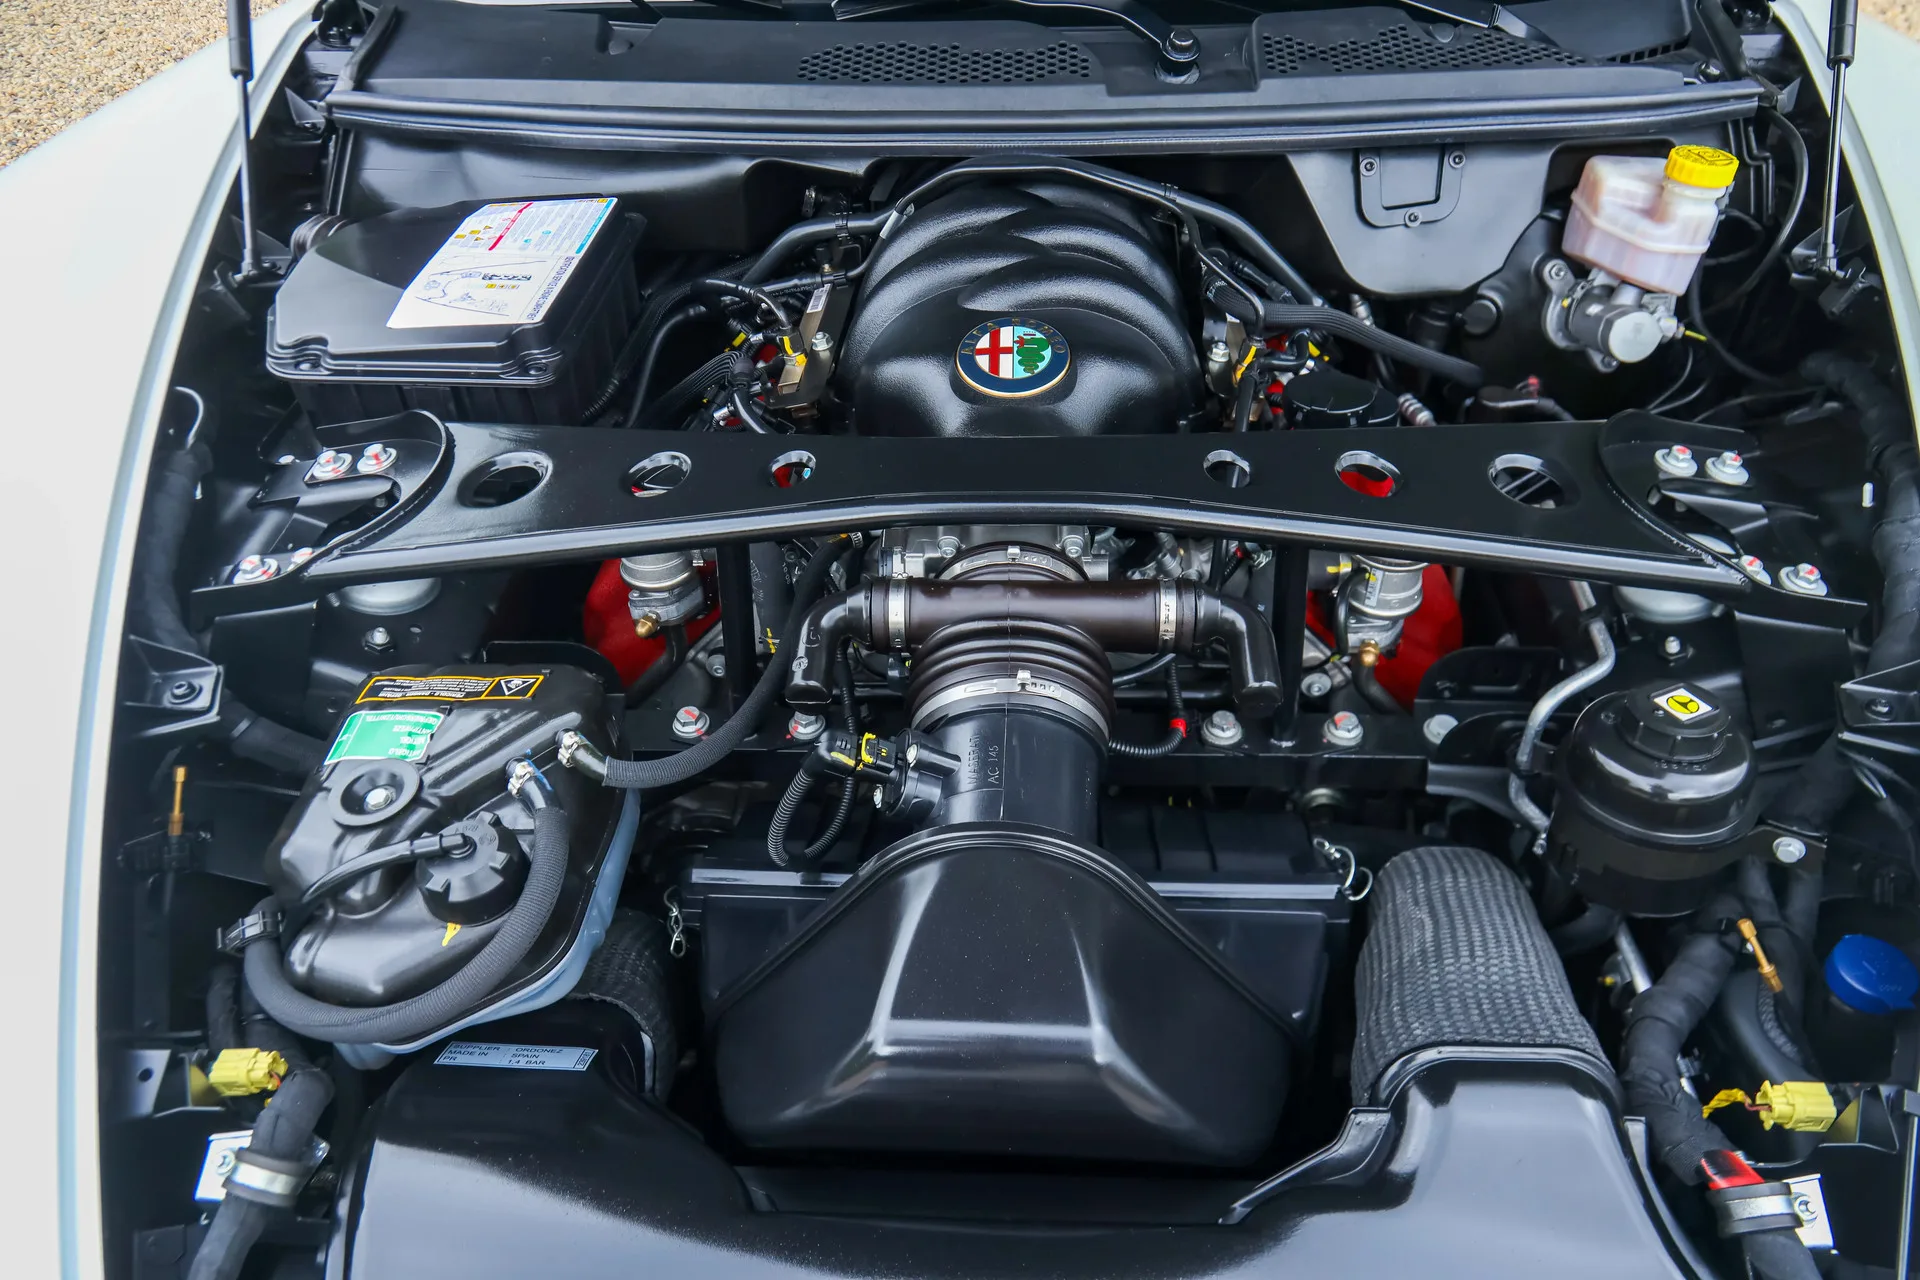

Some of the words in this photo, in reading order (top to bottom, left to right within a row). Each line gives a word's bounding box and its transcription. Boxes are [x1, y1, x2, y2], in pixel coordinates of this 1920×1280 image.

[961, 322, 998, 354] ALFA
[1012, 318, 1067, 353] ROMEO
[388, 748, 421, 757] ANTIGELO
[988, 745, 999, 761] 145
[988, 767, 999, 784] AC
